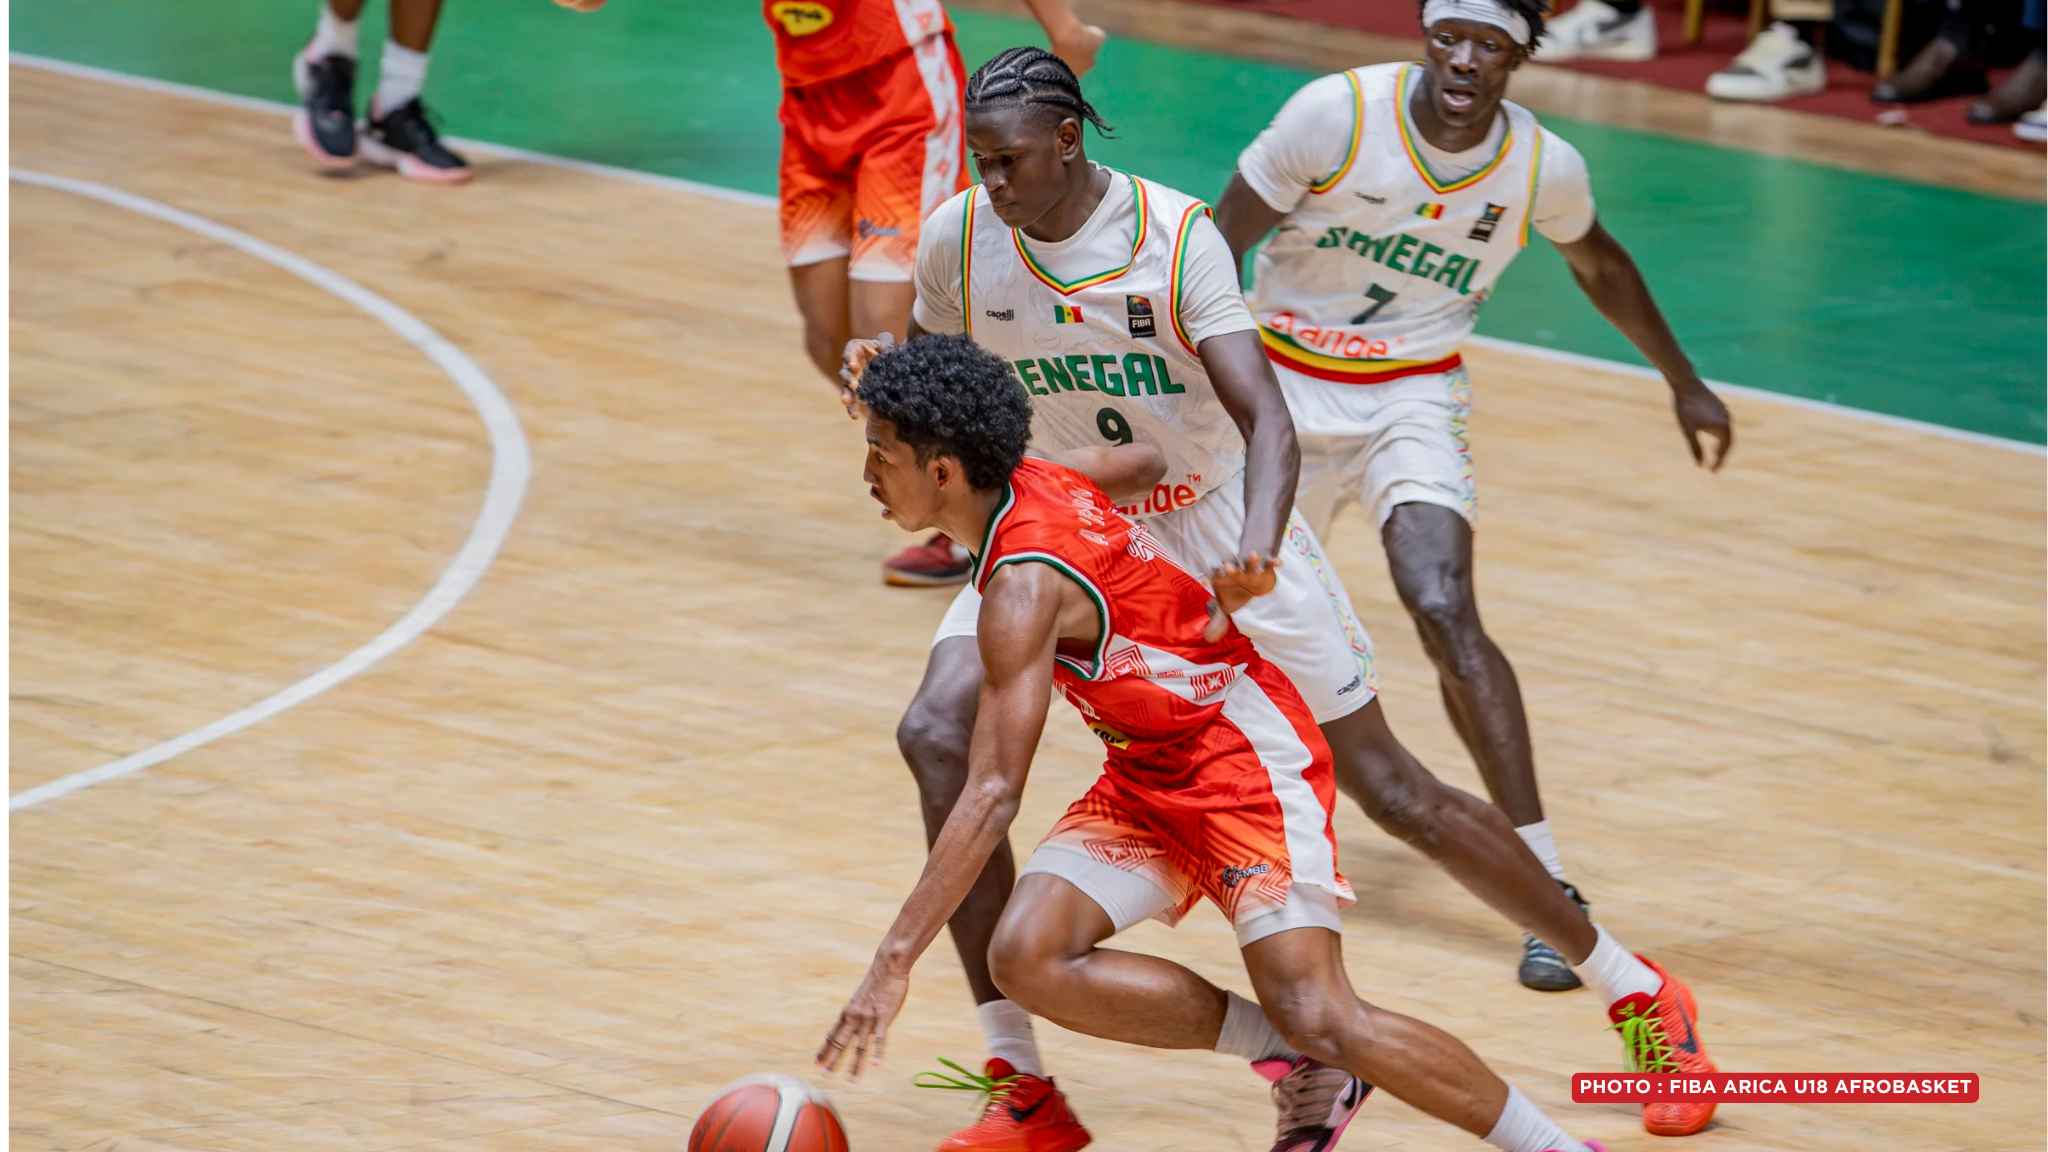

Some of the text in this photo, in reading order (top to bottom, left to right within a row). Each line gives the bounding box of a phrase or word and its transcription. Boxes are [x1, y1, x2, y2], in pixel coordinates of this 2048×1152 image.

[1351, 283, 1399, 325] 7
[1011, 352, 1186, 396] ENEGAL
[1096, 407, 1133, 447] 9
